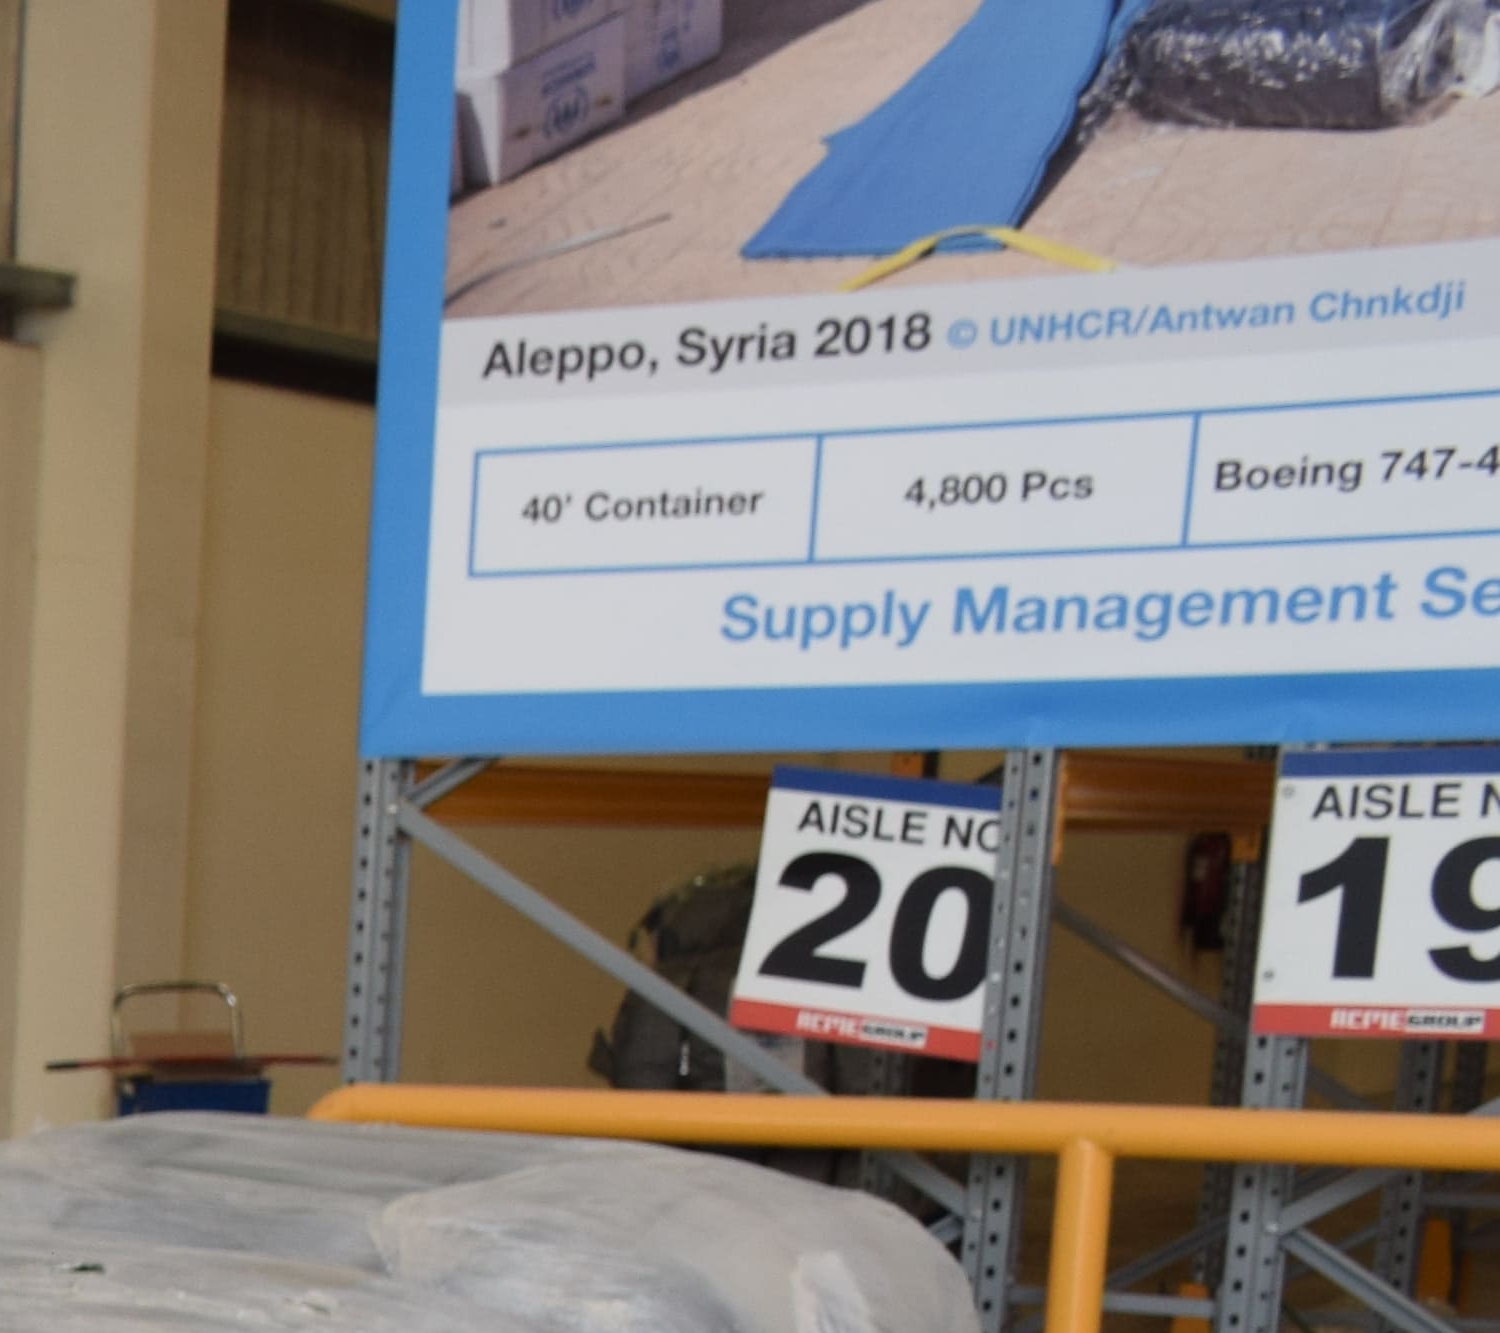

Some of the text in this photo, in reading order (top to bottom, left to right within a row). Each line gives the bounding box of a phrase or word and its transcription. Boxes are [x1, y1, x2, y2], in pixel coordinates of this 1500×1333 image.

[481, 338, 660, 384] Aleppo,
[675, 321, 798, 374] Syria
[813, 311, 933, 358] 2018
[989, 298, 1296, 348] UNHCR/Antwan
[1308, 281, 1467, 325] Chnkdji
[904, 471, 1095, 511] 4,800 Pcs
[1213, 455, 1365, 493] Boeing
[585, 487, 765, 524] Container
[721, 589, 932, 652] Supply
[950, 571, 1398, 642] Management
[1311, 781, 1463, 820] AISLE
[797, 801, 928, 845] AISLE
[757, 850, 995, 1004] 20
[1296, 836, 1500, 983] 19
